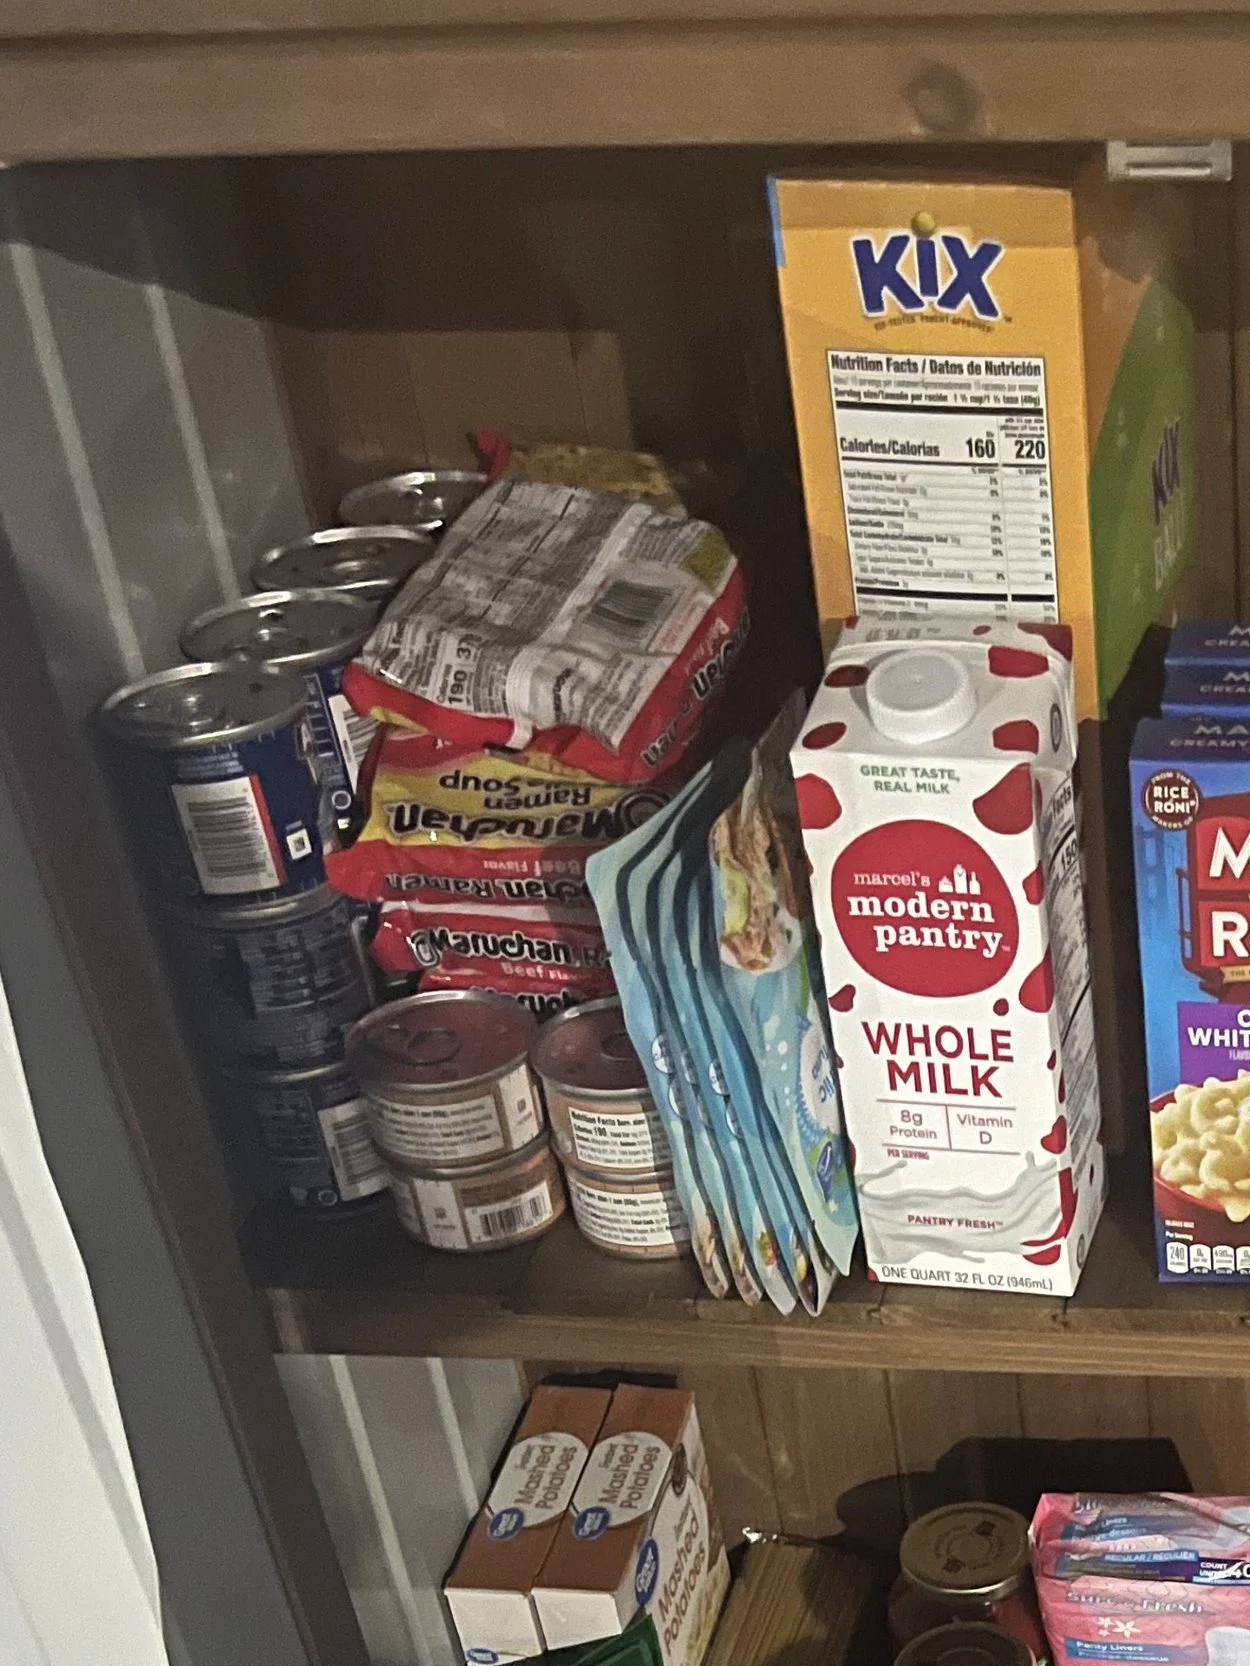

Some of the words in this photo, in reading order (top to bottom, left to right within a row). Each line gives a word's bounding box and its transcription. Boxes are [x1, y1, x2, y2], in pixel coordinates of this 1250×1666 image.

[831, 354, 883, 372] Nutrition
[885, 357, 919, 374] Facts
[929, 359, 964, 376] Datos
[966, 361, 982, 376] de
[984, 360, 1041, 377] Nutrición
[965, 437, 996, 459] 160
[1014, 439, 1046, 460] 220
[448, 669, 468, 705] 190
[439, 769, 521, 796] Soup
[860, 764, 908, 780] GREAT
[910, 766, 961, 783] TASTE,
[483, 786, 592, 811] Ramen
[873, 780, 913, 794] REAL
[915, 781, 950, 795] MILK
[1153, 785, 1190, 800] RICE
[853, 870, 932, 888] marcel's
[847, 890, 996, 924] modern
[430, 926, 573, 965] Maruchan
[873, 922, 1004, 959] pantry
[500, 961, 545, 980] Beef
[860, 1020, 1015, 1064] WHOLE
[886, 1058, 1003, 1099] MILK
[900, 1110, 923, 1127] 8g
[956, 1113, 1013, 1130] Vitamin
[889, 1125, 938, 1141] Protein
[979, 1130, 993, 1145] D
[907, 1214, 955, 1228] PANTRY
[1169, 1246, 1186, 1261] 240
[881, 1265, 908, 1280] ONE
[910, 1267, 952, 1283] QUART
[954, 1271, 970, 1285] 32
[972, 1272, 985, 1286] FL
[987, 1273, 1005, 1287] OZ
[515, 1444, 557, 1505] Mashed
[535, 1445, 577, 1510] Potatoes
[599, 1443, 640, 1505] Mashed
[620, 1445, 661, 1510] Potatoes
[657, 1509, 699, 1623] Mashed
[1103, 1552, 1146, 1563] REGULAR
[1200, 1561, 1228, 1570] COUNT
[663, 1541, 706, 1657] Potatoes
[1108, 1643, 1144, 1652] Liners
